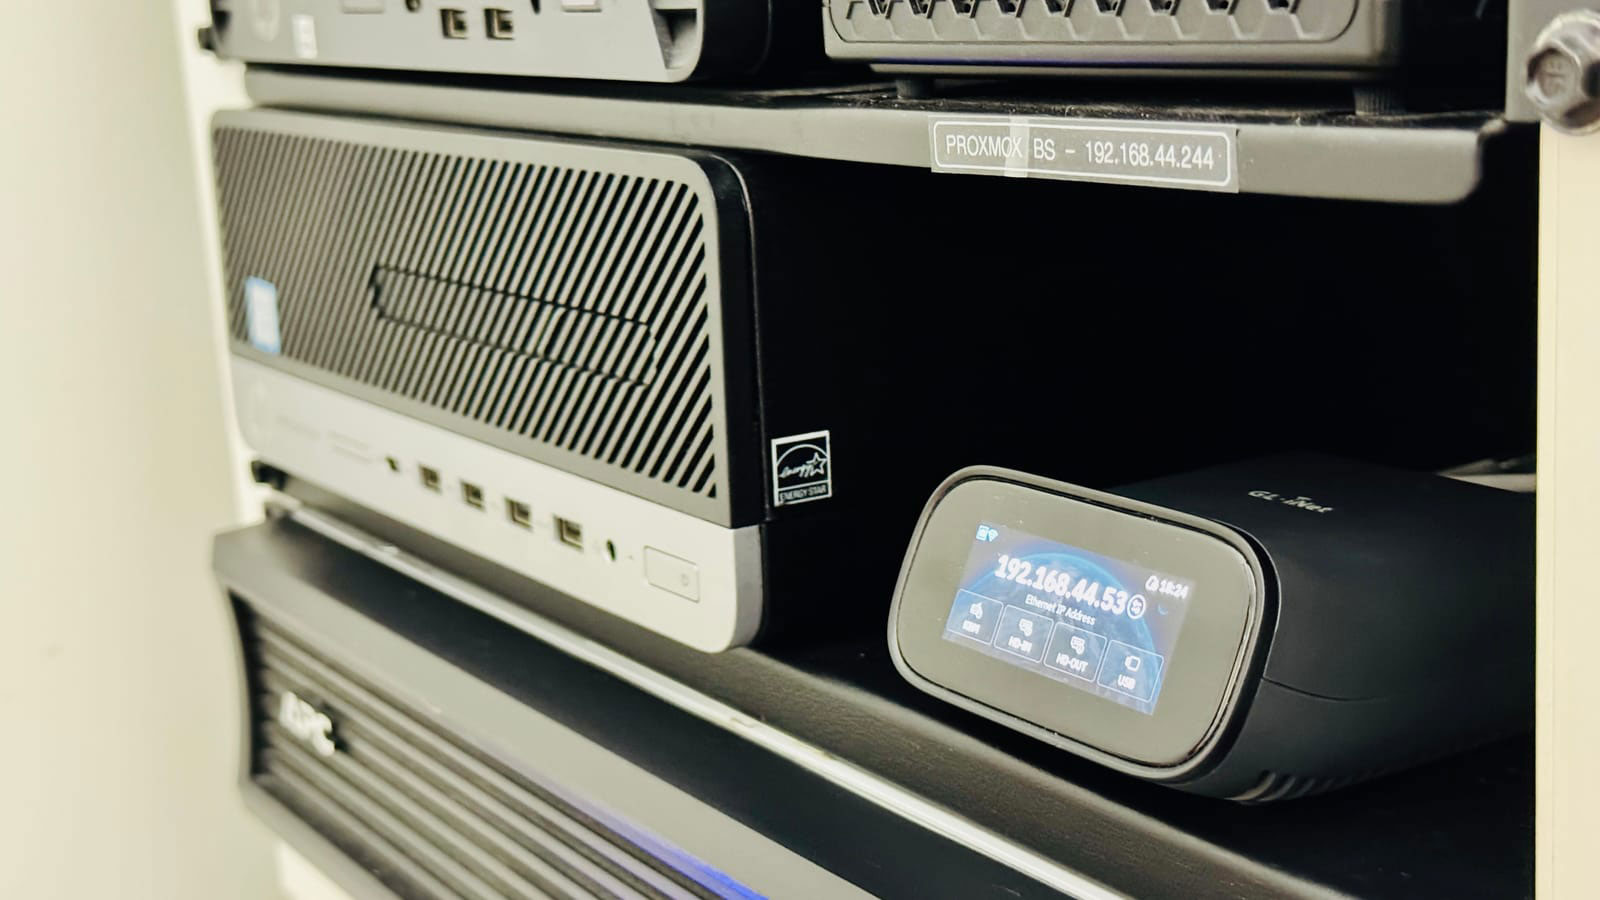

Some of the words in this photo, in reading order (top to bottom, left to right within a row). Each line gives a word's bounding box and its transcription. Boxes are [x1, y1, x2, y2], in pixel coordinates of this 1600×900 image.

[945, 134, 1023, 158] PROXMOX
[1033, 137, 1056, 161] BS
[1085, 140, 1215, 170] 192.168.44.244
[780, 488, 808, 503] ENERGY
[808, 484, 827, 497] STAR
[994, 554, 1128, 615] 192.168.44.53
[1025, 593, 1057, 614] Ethernet
[1056, 603, 1067, 616] IP
[1065, 607, 1097, 626] Address
[1056, 652, 1089, 673] HD-OUT
[1117, 673, 1136, 690] USB
[279, 690, 336, 756] APC
